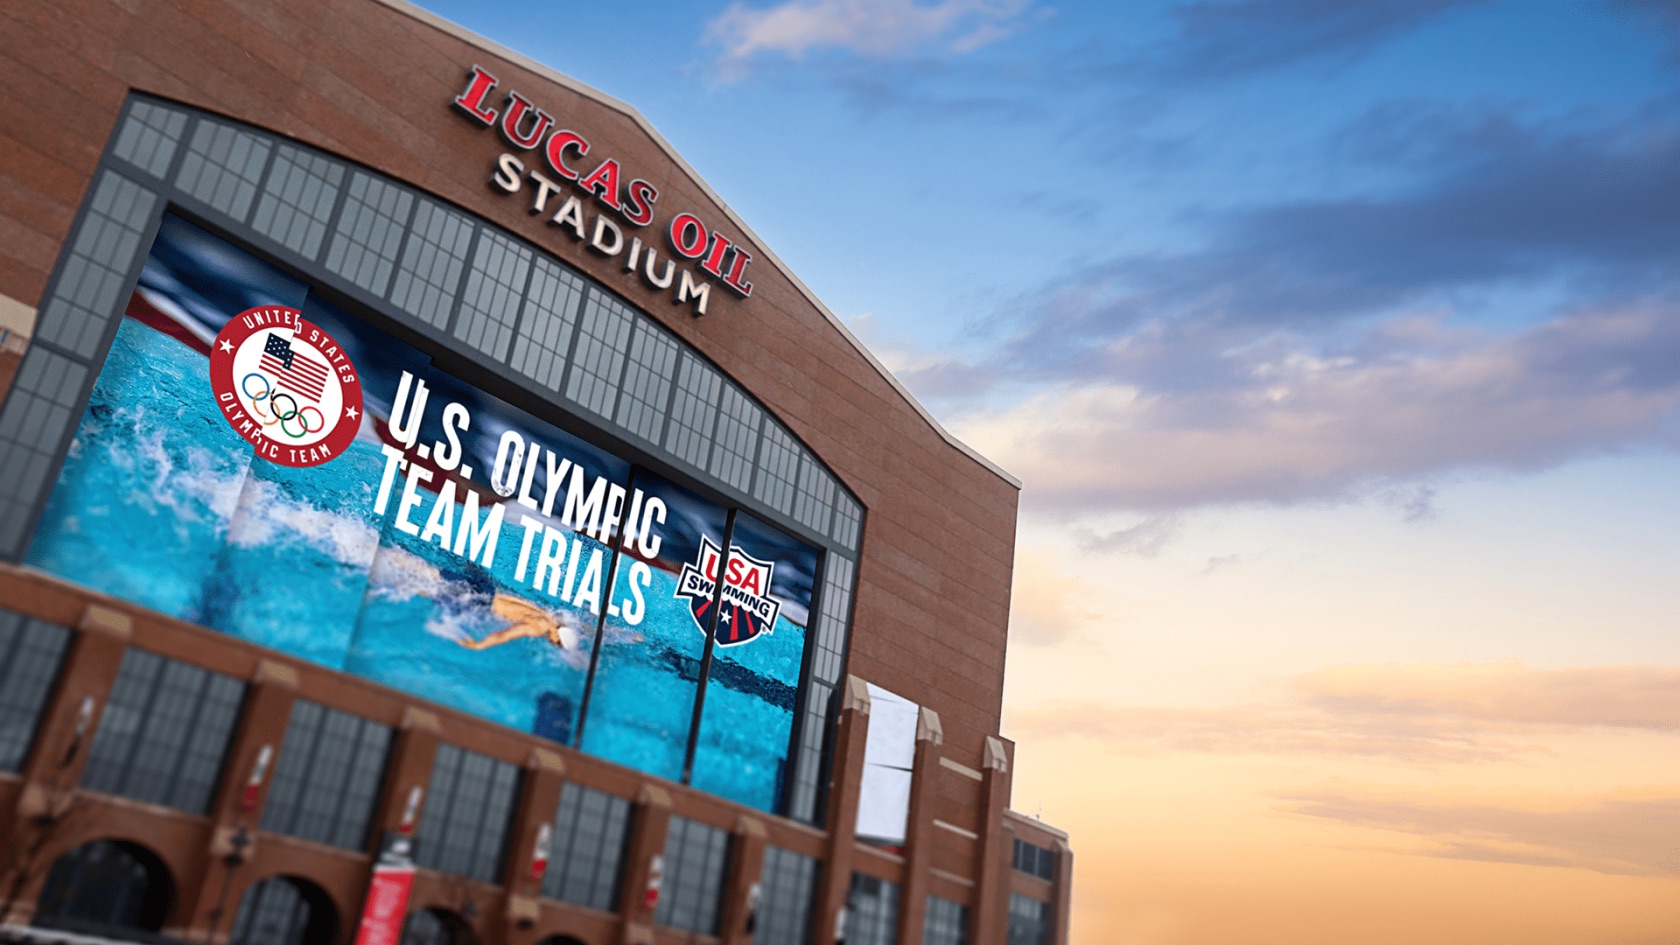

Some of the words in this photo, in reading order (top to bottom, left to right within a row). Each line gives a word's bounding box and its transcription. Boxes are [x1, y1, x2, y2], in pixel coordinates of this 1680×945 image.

[452, 64, 658, 227] LUCAS
[669, 213, 754, 298] OIL
[492, 153, 711, 315] STADIUM
[242, 310, 302, 334] UNITED
[309, 330, 355, 384] STATES
[219, 391, 280, 457] OLYMPIC
[289, 444, 332, 463] TEAM
[388, 370, 473, 479] U.S.
[491, 430, 667, 559] OLYMPIC
[373, 444, 505, 569] TEAM
[513, 514, 652, 625] TRIALS
[705, 553, 761, 596] USA
[686, 574, 770, 618] SWMMING
